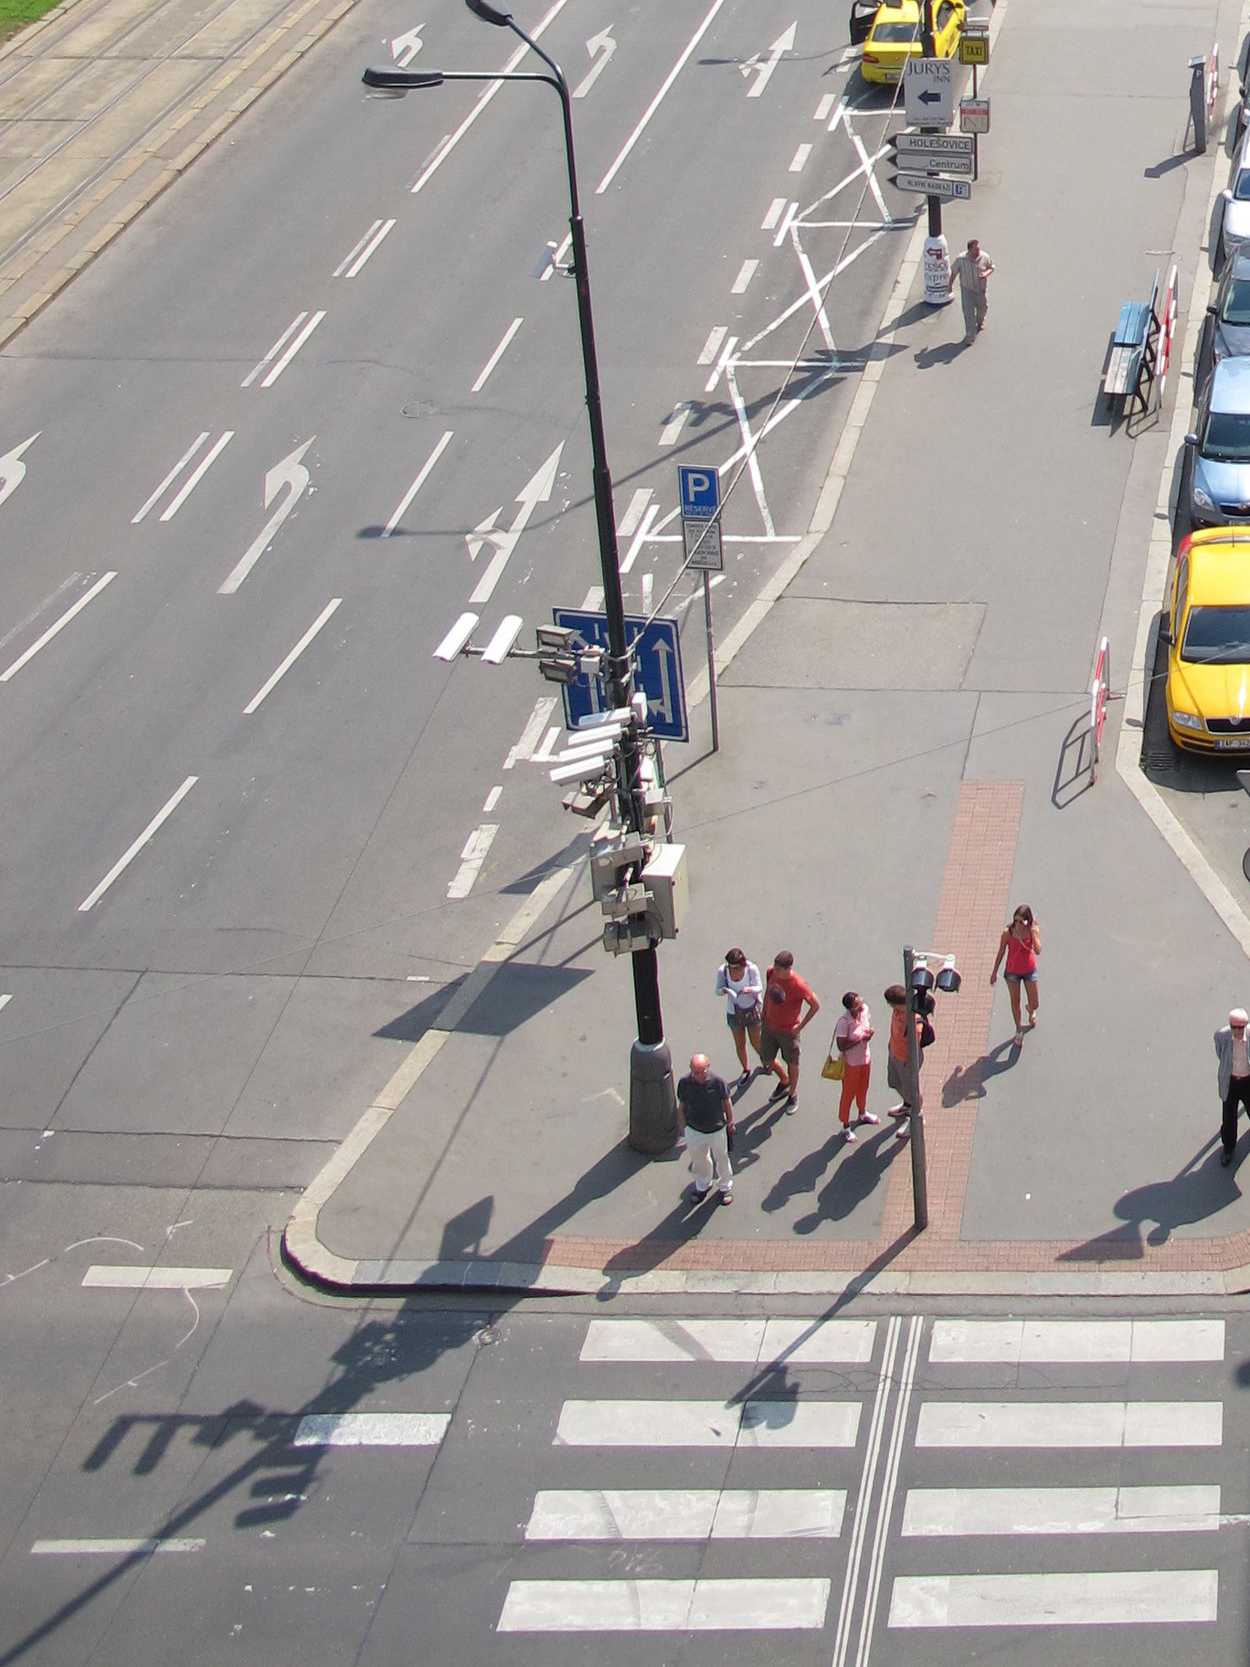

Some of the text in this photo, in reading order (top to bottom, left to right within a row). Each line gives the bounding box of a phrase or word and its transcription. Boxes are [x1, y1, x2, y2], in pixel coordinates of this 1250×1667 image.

[966, 45, 983, 56] TAXI
[907, 62, 950, 76] JURYS
[909, 137, 970, 150] HOLEŠOVICE
[929, 159, 969, 170] Centrum
[687, 473, 710, 502] P
